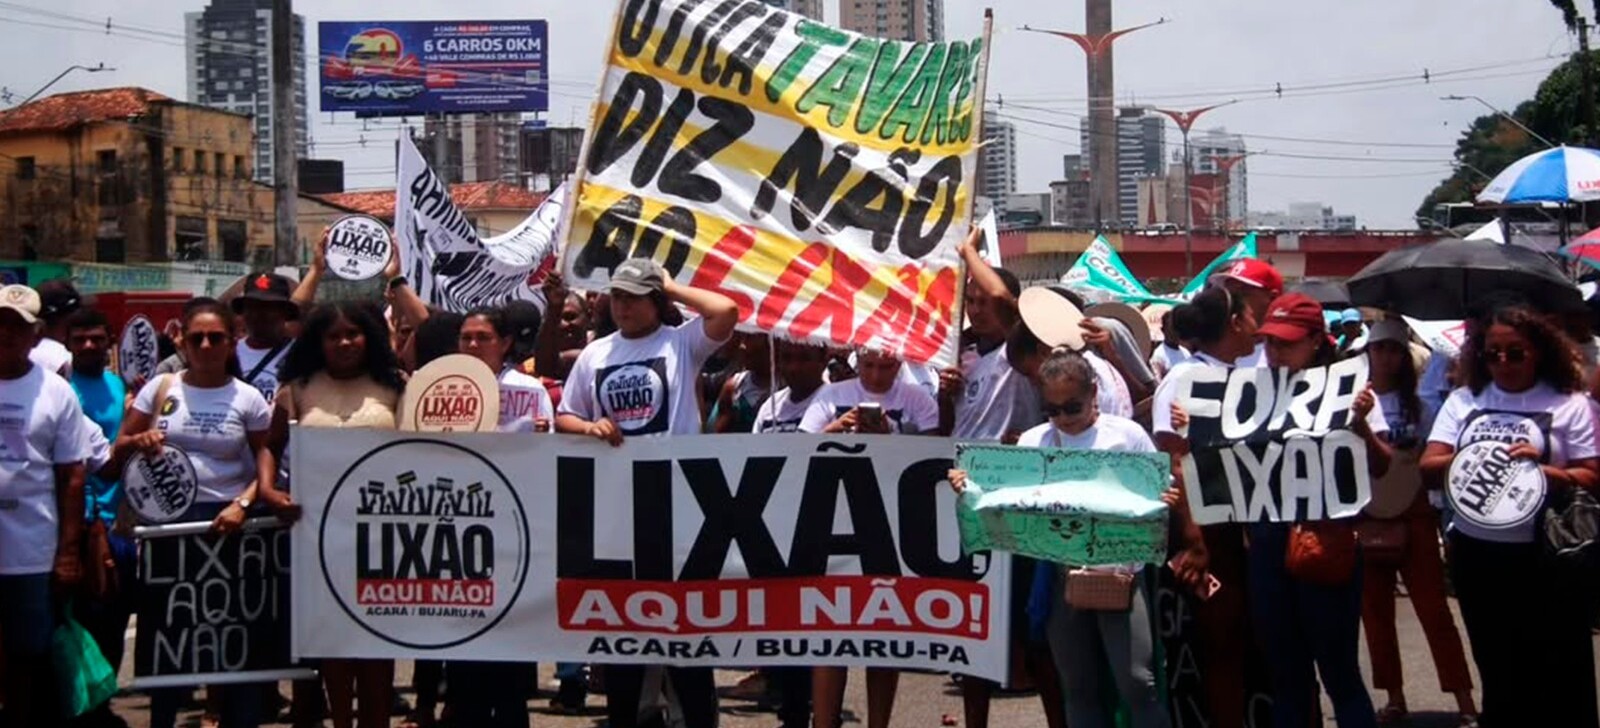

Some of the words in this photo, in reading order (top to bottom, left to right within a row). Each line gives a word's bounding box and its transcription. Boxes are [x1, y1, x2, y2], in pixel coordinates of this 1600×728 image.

[424, 40, 434, 53] 6
[437, 38, 503, 53] CARROS
[586, 71, 754, 204] DIZ
[750, 126, 962, 259] NÃO
[572, 194, 697, 280] AO
[689, 224, 956, 364] LIXÃO
[1171, 352, 1371, 438] FORA
[165, 577, 279, 628] AQUI
[360, 583, 422, 603] AQUI
[431, 581, 491, 604] NÃO!
[365, 606, 409, 617] ACARÁ
[419, 606, 486, 619] BUJARU-PA
[569, 588, 766, 632] AQUI
[800, 578, 984, 634] NÃO!
[587, 636, 720, 658] ACARÁ
[732, 639, 742, 657] /
[756, 637, 970, 666] BUJARU-PA
